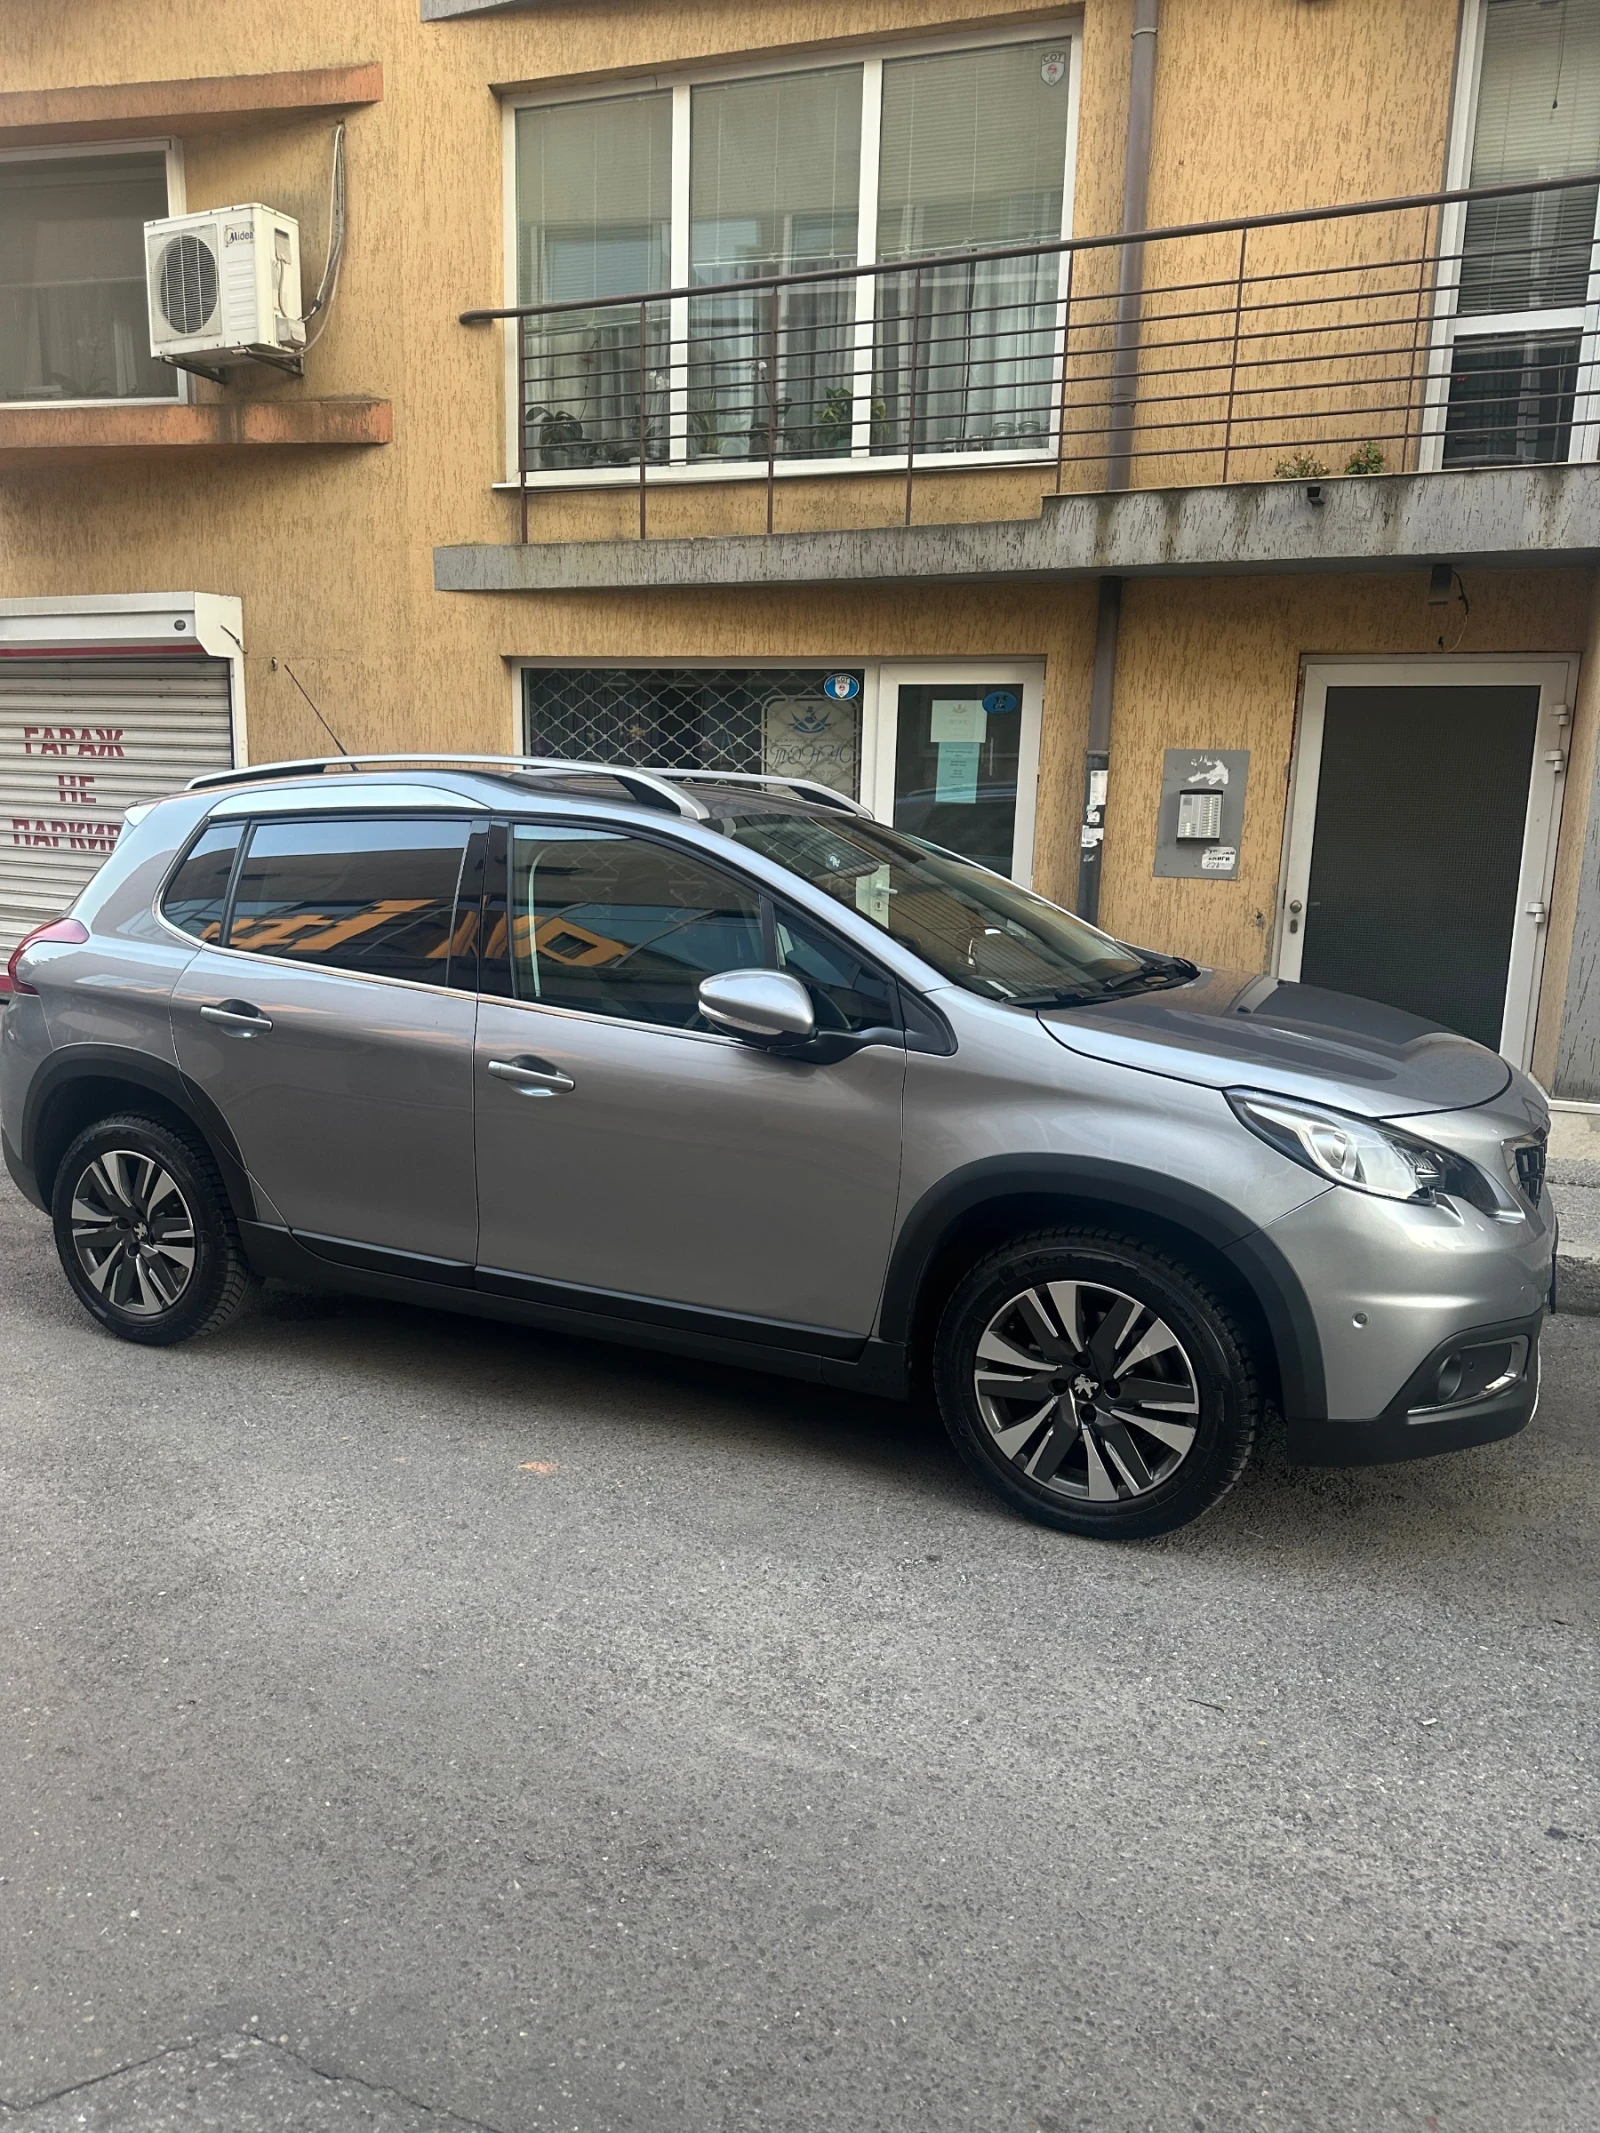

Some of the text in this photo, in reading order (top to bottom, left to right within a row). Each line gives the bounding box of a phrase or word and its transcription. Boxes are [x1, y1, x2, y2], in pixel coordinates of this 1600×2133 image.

[230, 230, 254, 242] Midea
[24, 727, 125, 757] ГАРАЖ
[58, 774, 97, 804] НЕ
